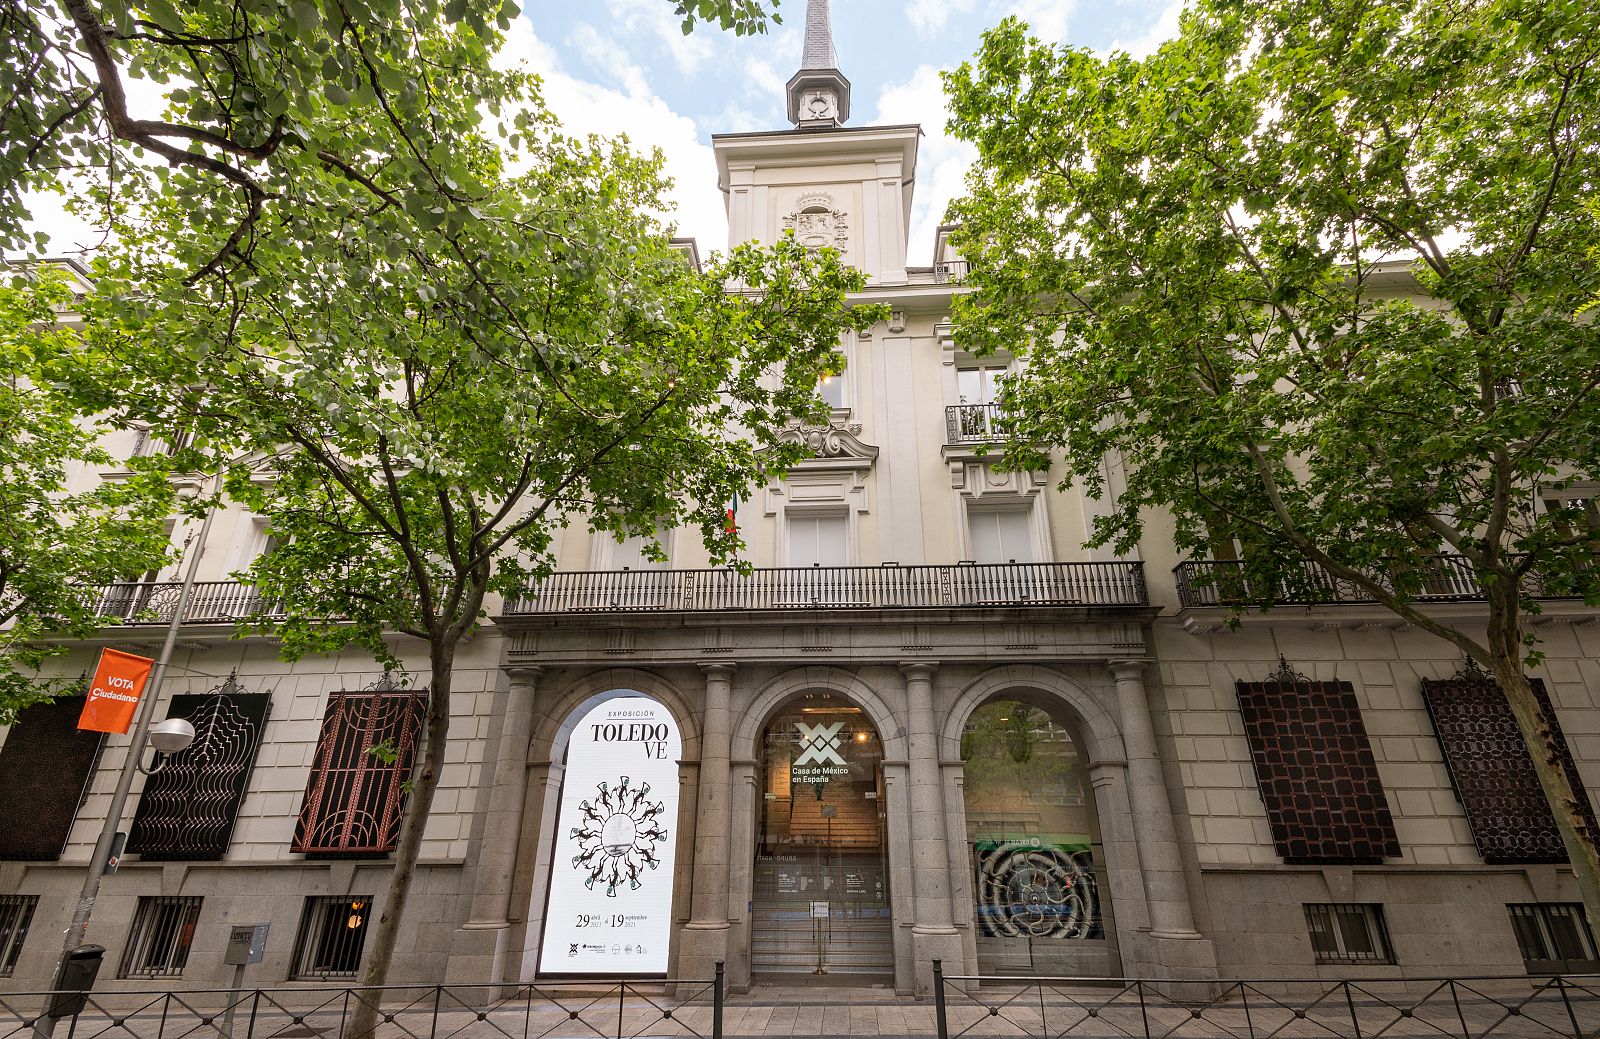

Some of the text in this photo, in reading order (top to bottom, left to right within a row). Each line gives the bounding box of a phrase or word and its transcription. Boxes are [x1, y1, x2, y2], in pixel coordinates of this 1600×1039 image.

[108, 676, 134, 690] VOTA
[92, 687, 138, 703] Ciudadano
[591, 723, 669, 742] TOLEDO
[644, 741, 668, 760] VE
[792, 767, 849, 775] Casa de México
[803, 775, 829, 784] España
[575, 914, 590, 928] 29
[611, 914, 625, 928] 19
